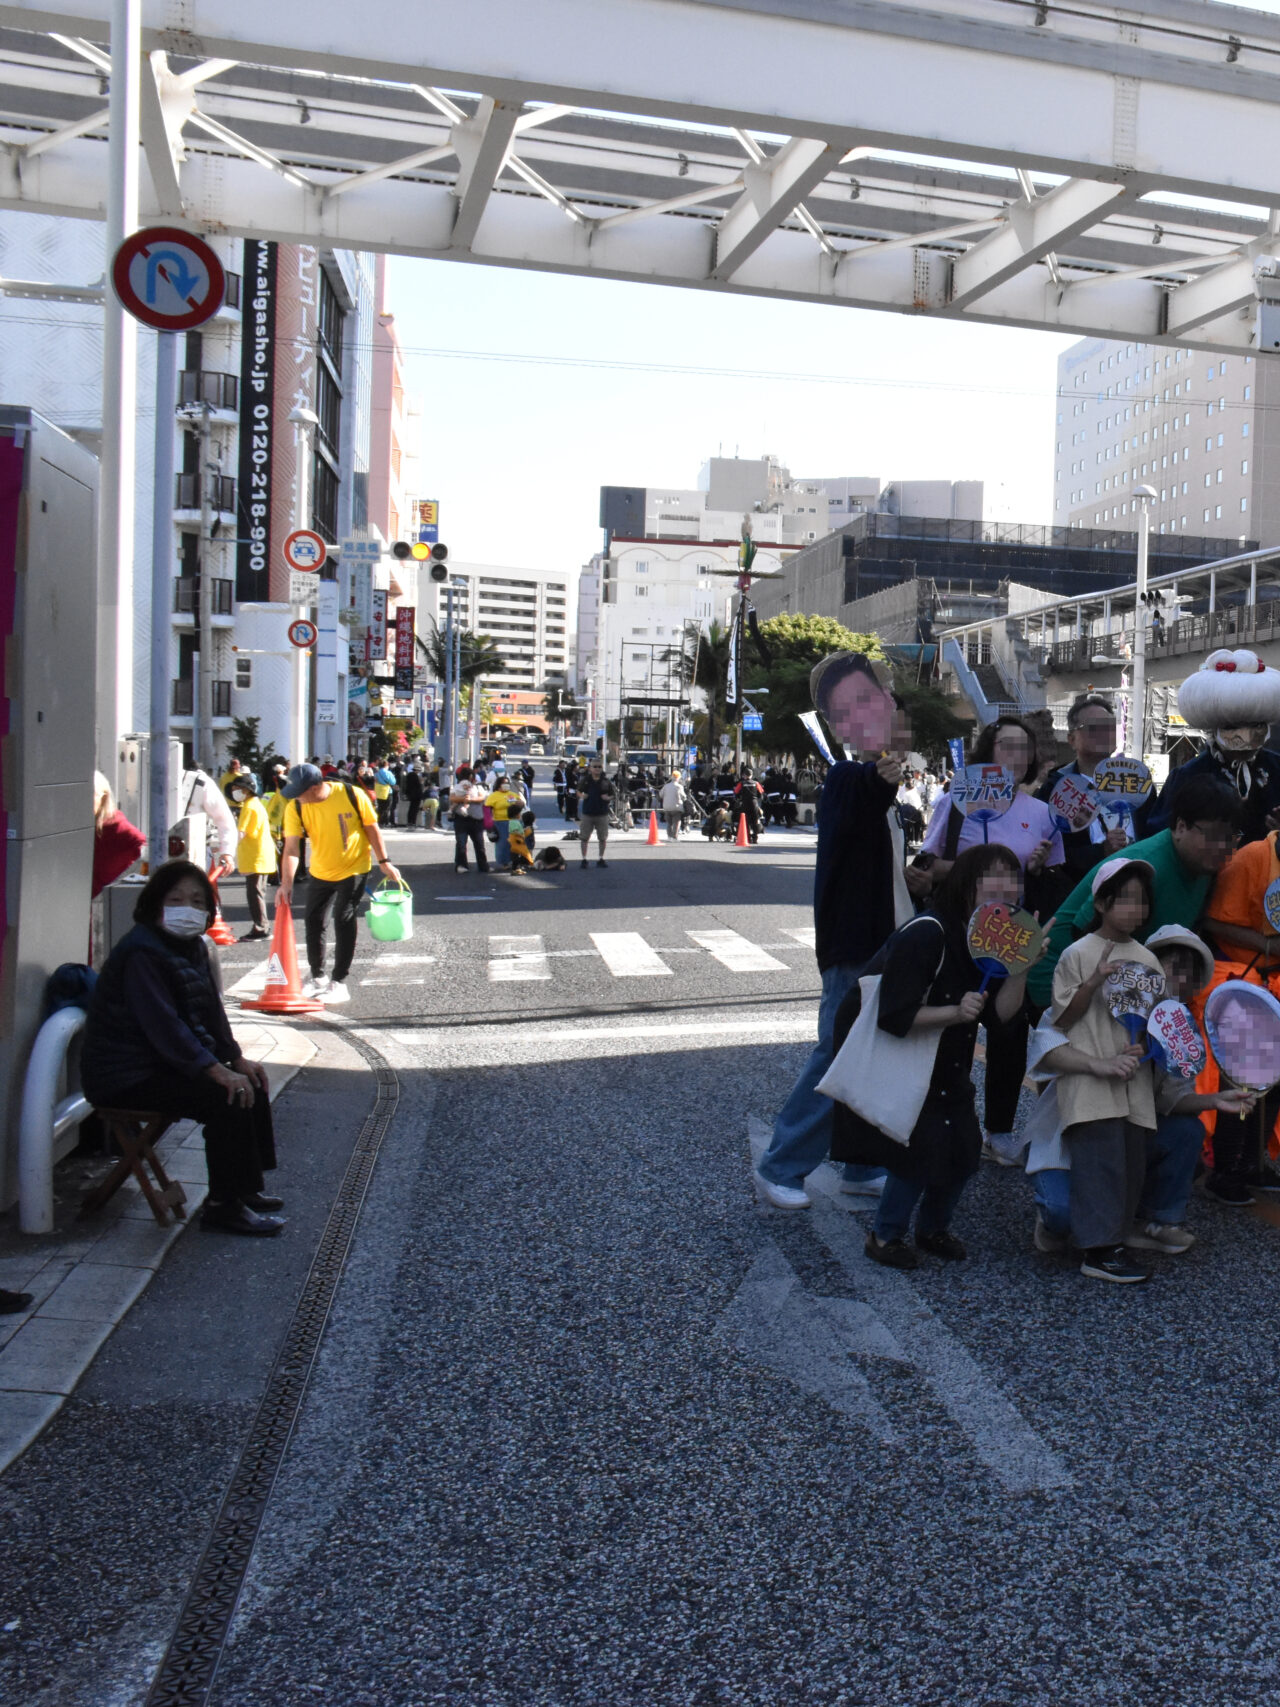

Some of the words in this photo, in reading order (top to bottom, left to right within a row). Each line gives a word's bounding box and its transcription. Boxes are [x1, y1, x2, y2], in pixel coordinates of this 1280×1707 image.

[249, 404, 269, 571] 0120-218-900
[1062, 778, 1096, 812] ラッキー
[1154, 1008, 1193, 1078] ももちゃん
[1170, 1007, 1201, 1061] 珊瑚の
